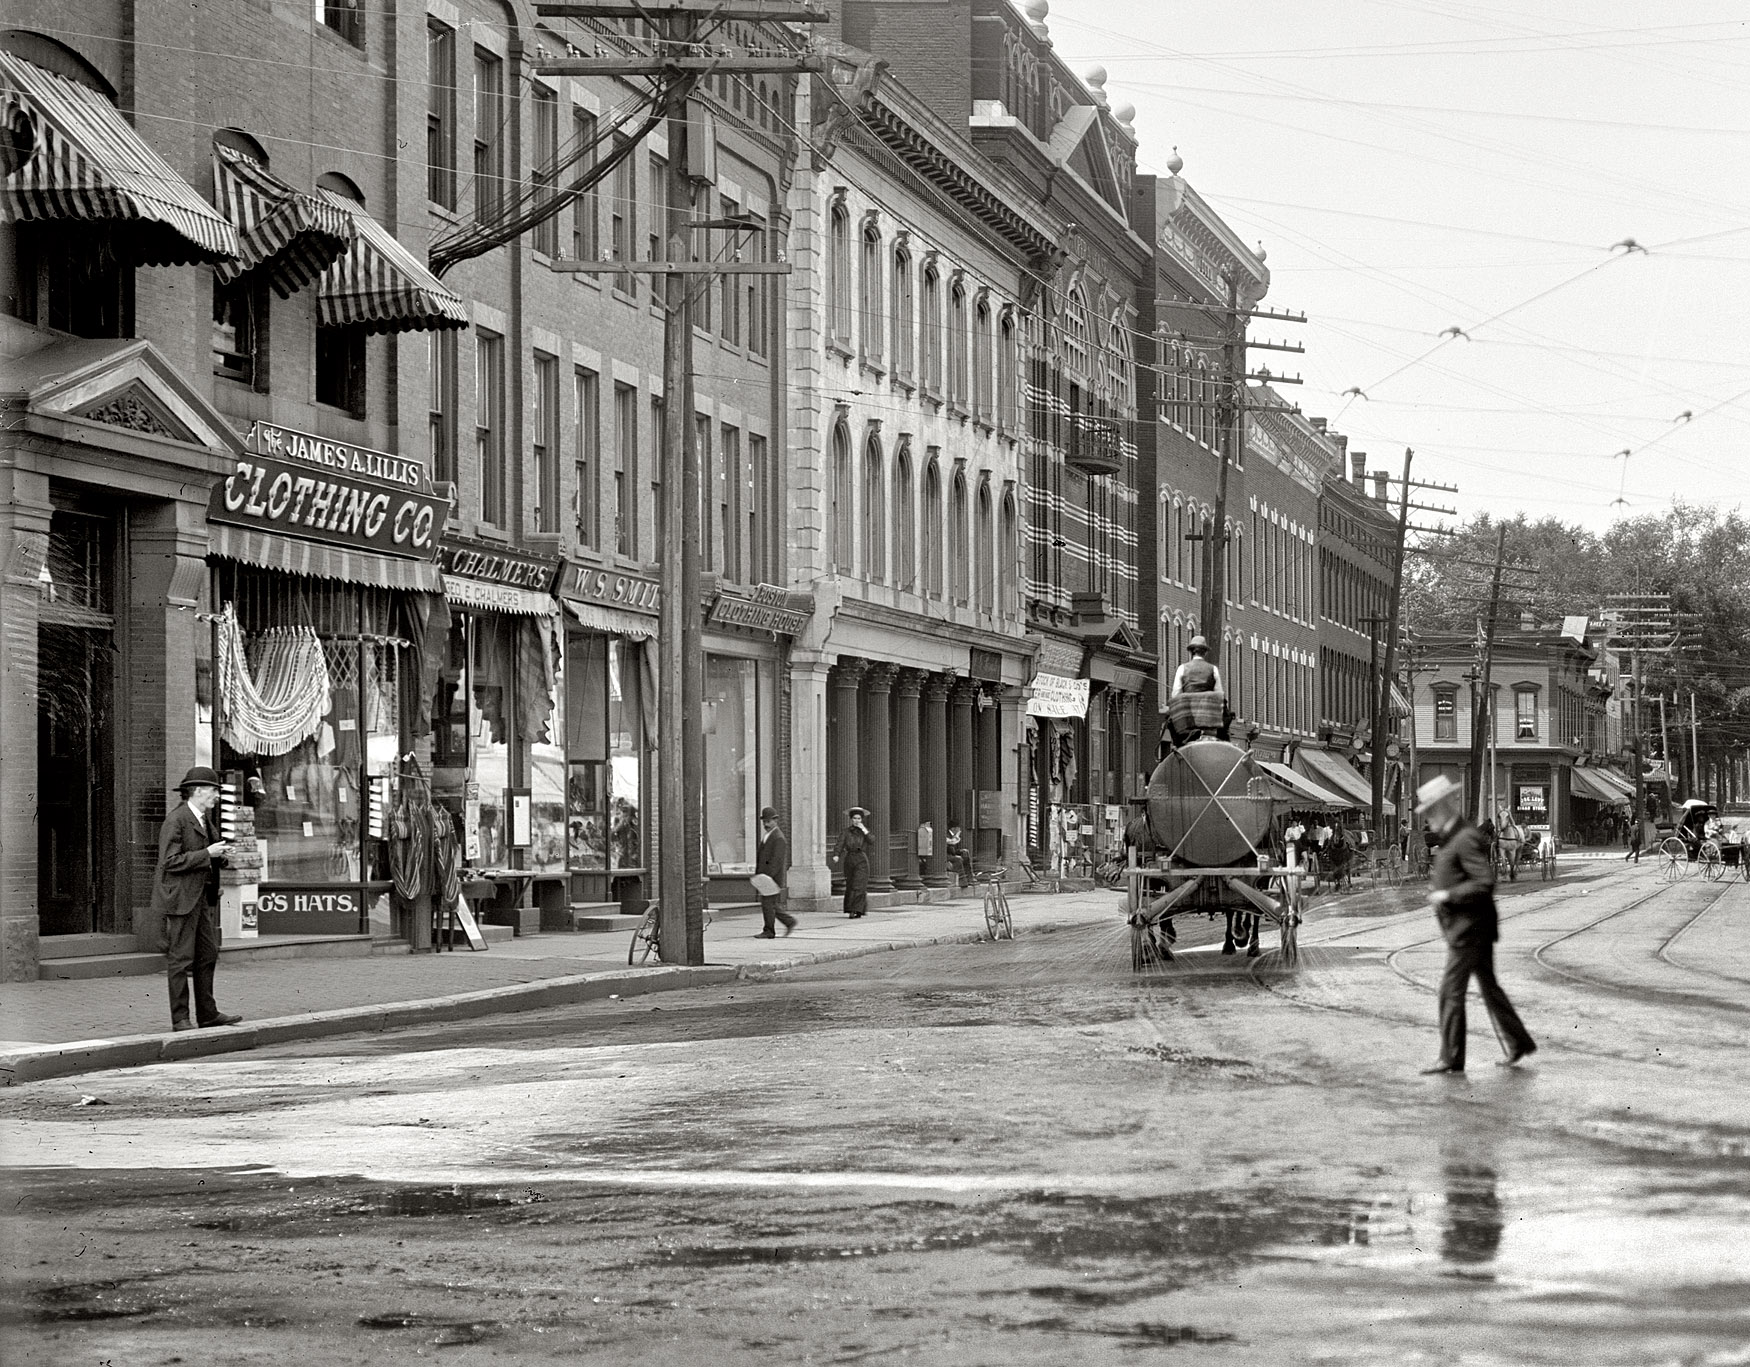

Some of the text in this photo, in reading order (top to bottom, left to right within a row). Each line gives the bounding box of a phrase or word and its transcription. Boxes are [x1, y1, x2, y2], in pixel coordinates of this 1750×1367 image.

[262, 427, 283, 455] The
[285, 435, 347, 469] JAMES
[364, 454, 419, 486] LILLIS
[224, 462, 434, 549] CLOTHING CO.
[474, 585, 519, 607] CHALMERS
[574, 567, 660, 610] W. S. SMIT
[758, 587, 787, 608] BOSTON
[718, 602, 804, 632] CLOTHING HOUSE
[293, 894, 358, 912] HATS.
